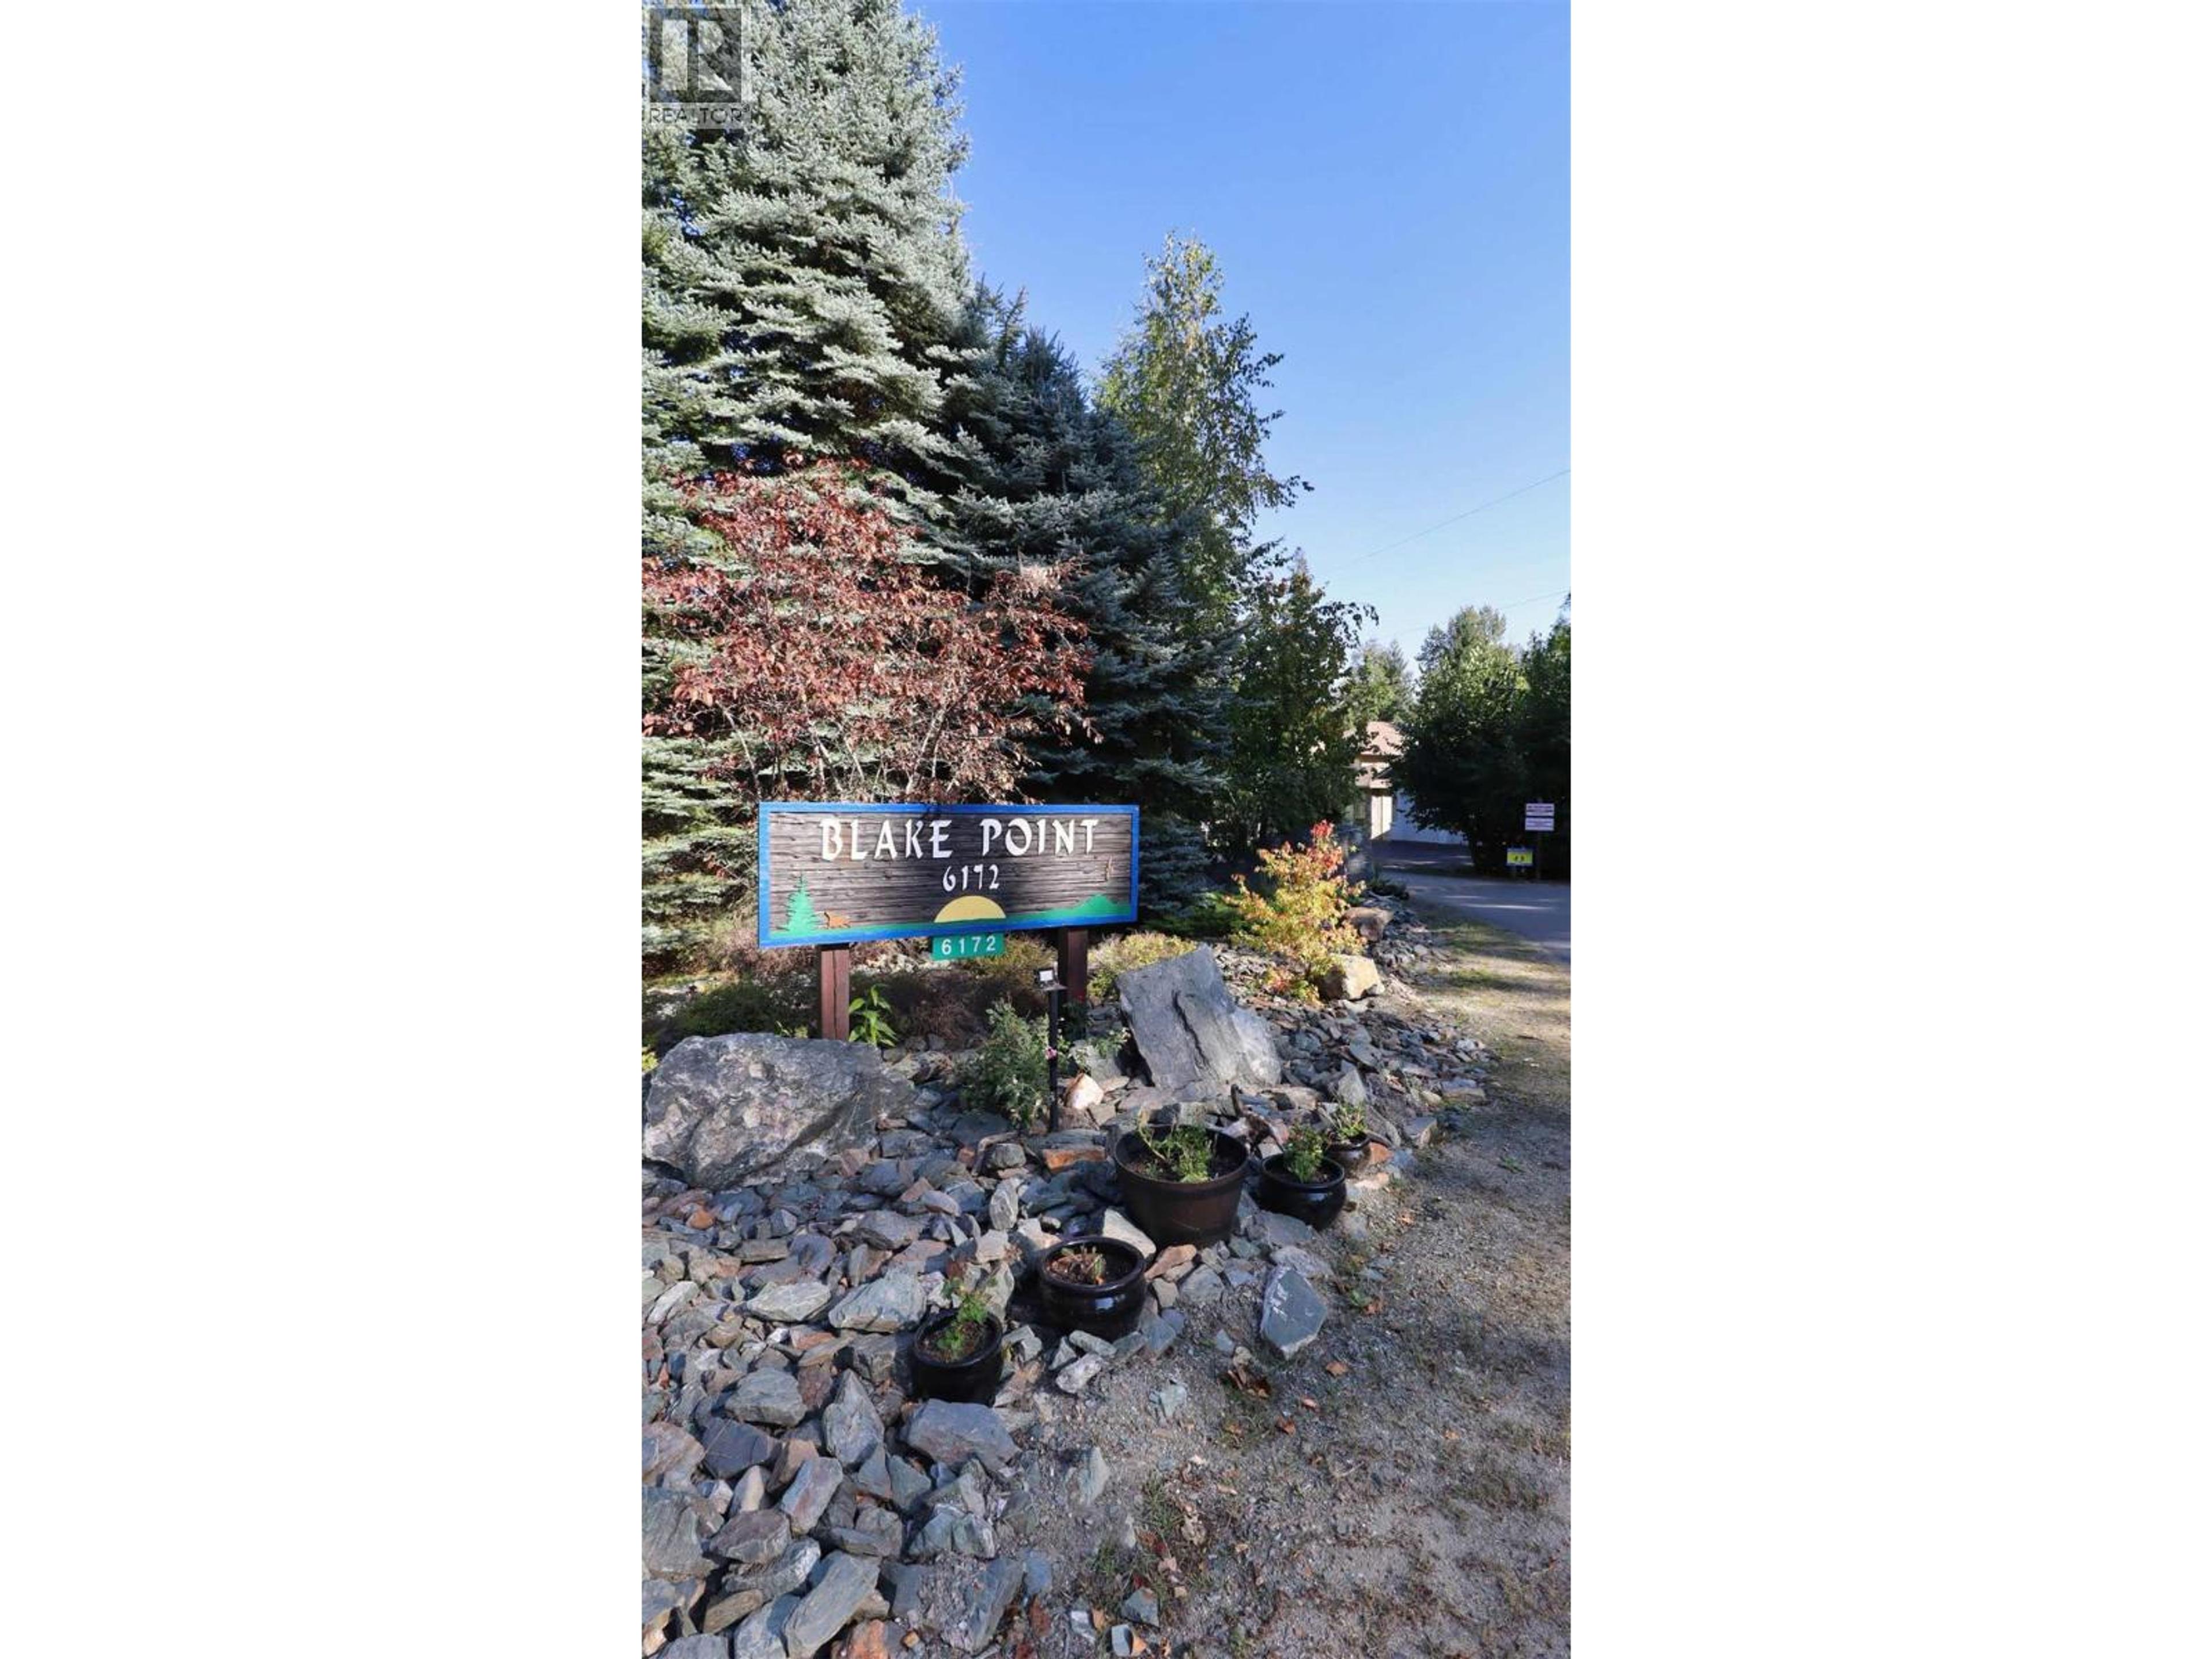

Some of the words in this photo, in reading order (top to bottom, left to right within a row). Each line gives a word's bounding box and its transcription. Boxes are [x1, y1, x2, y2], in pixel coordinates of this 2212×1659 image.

[820, 818, 952, 861] BLAKE
[979, 817, 1099, 857] POINT
[942, 865, 999, 892] 6172
[941, 935, 996, 955] 6172
